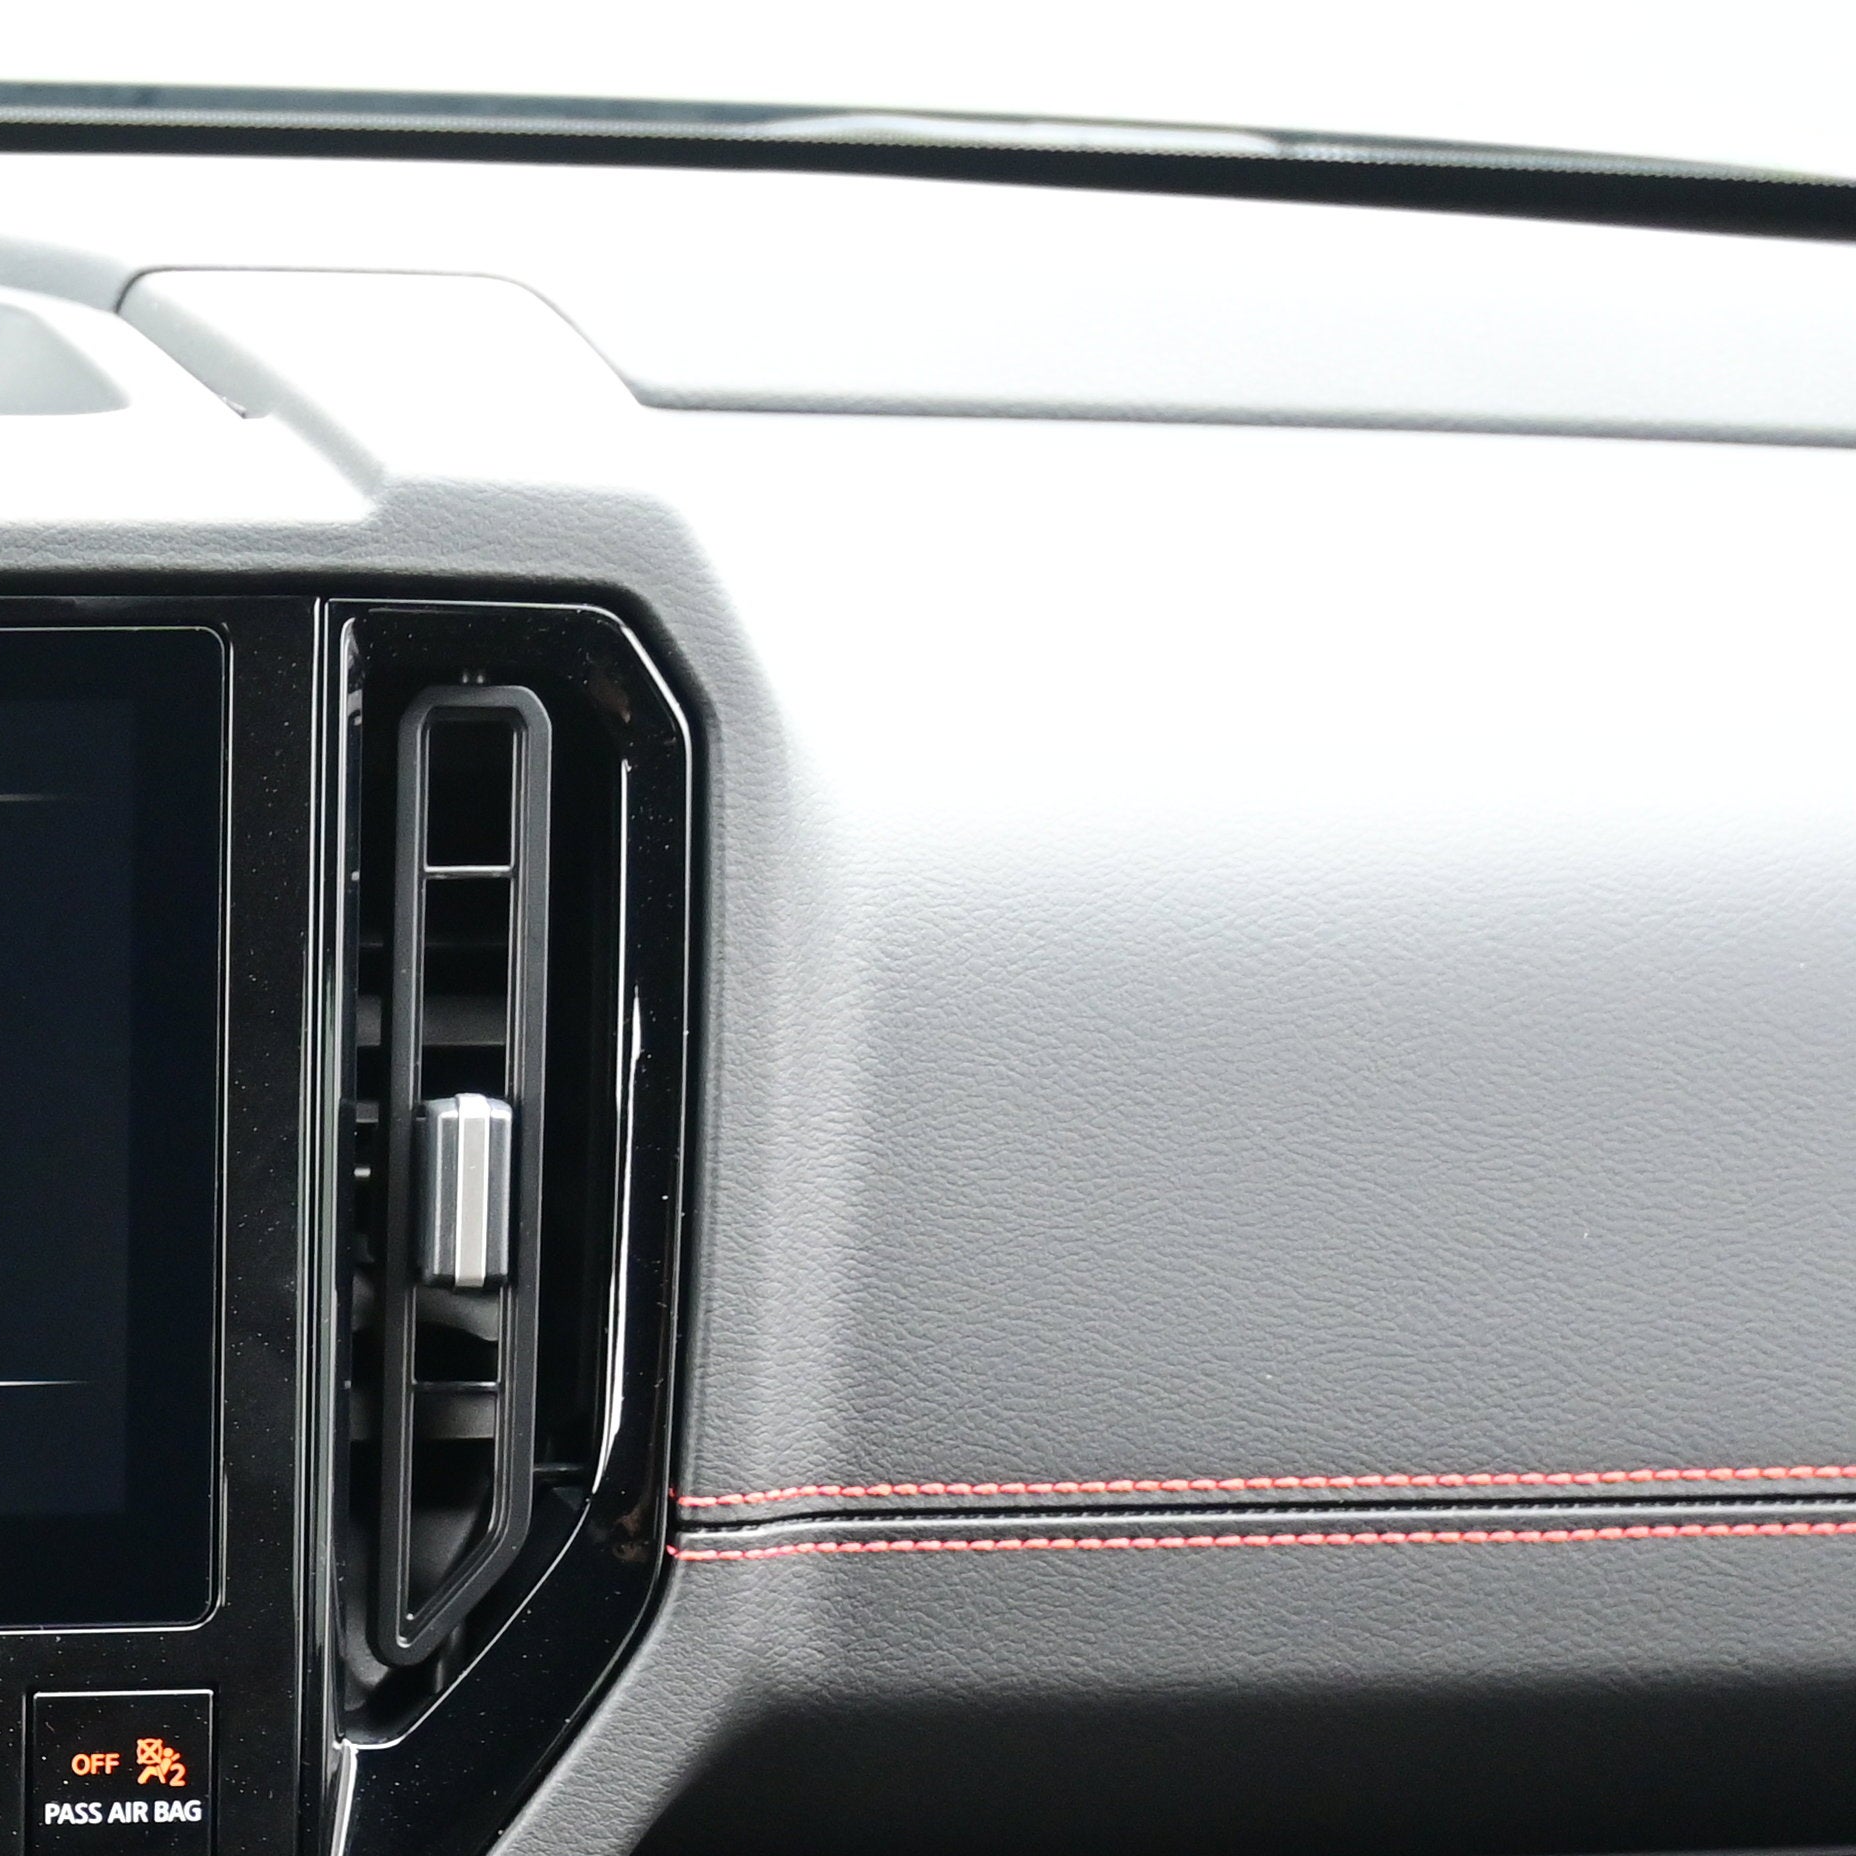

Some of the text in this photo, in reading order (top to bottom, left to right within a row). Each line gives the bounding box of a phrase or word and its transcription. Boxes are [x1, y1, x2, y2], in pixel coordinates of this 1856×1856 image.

[71, 1752, 120, 1777] OFF
[43, 1800, 202, 1825] PASS AIR BAG
